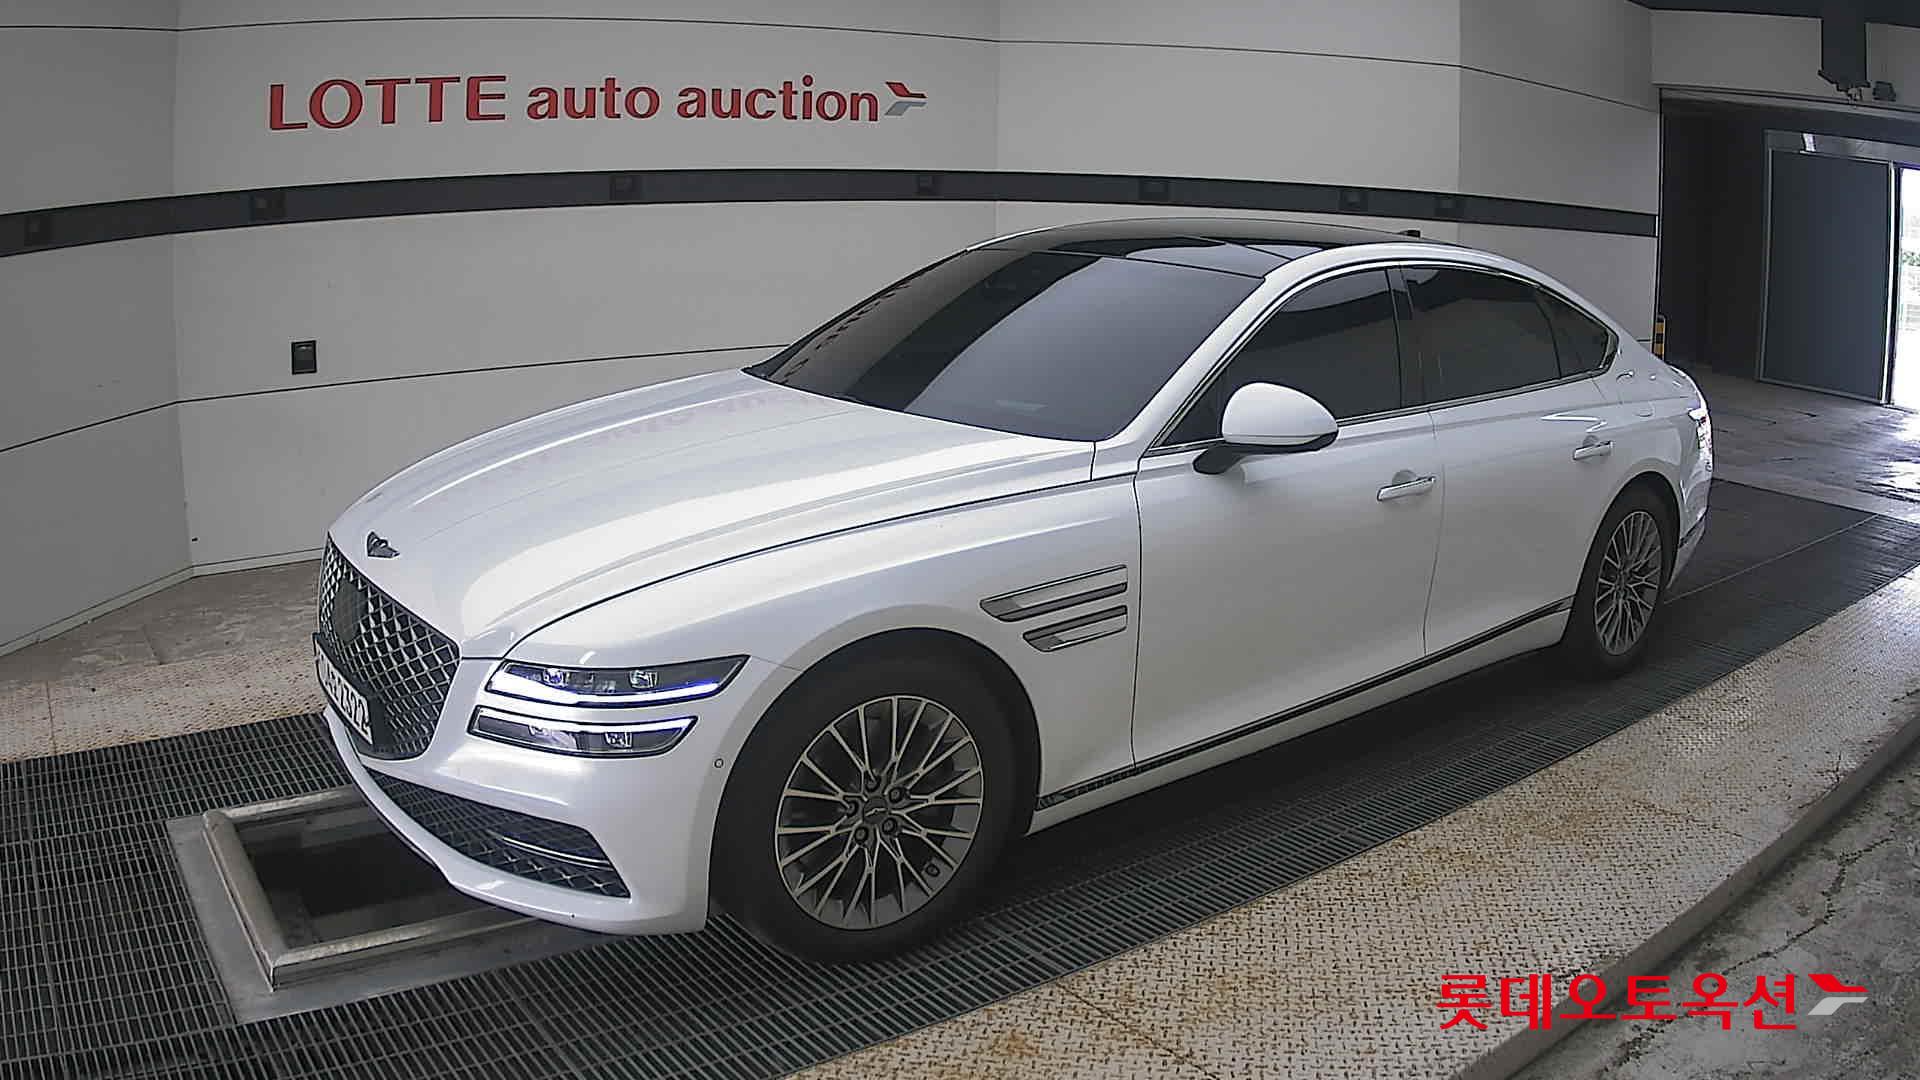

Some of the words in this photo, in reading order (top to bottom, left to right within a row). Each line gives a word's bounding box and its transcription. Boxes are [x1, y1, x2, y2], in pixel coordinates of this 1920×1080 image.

[269, 75, 507, 130] LOTTE
[526, 77, 661, 120] auto
[676, 75, 880, 122] auction
